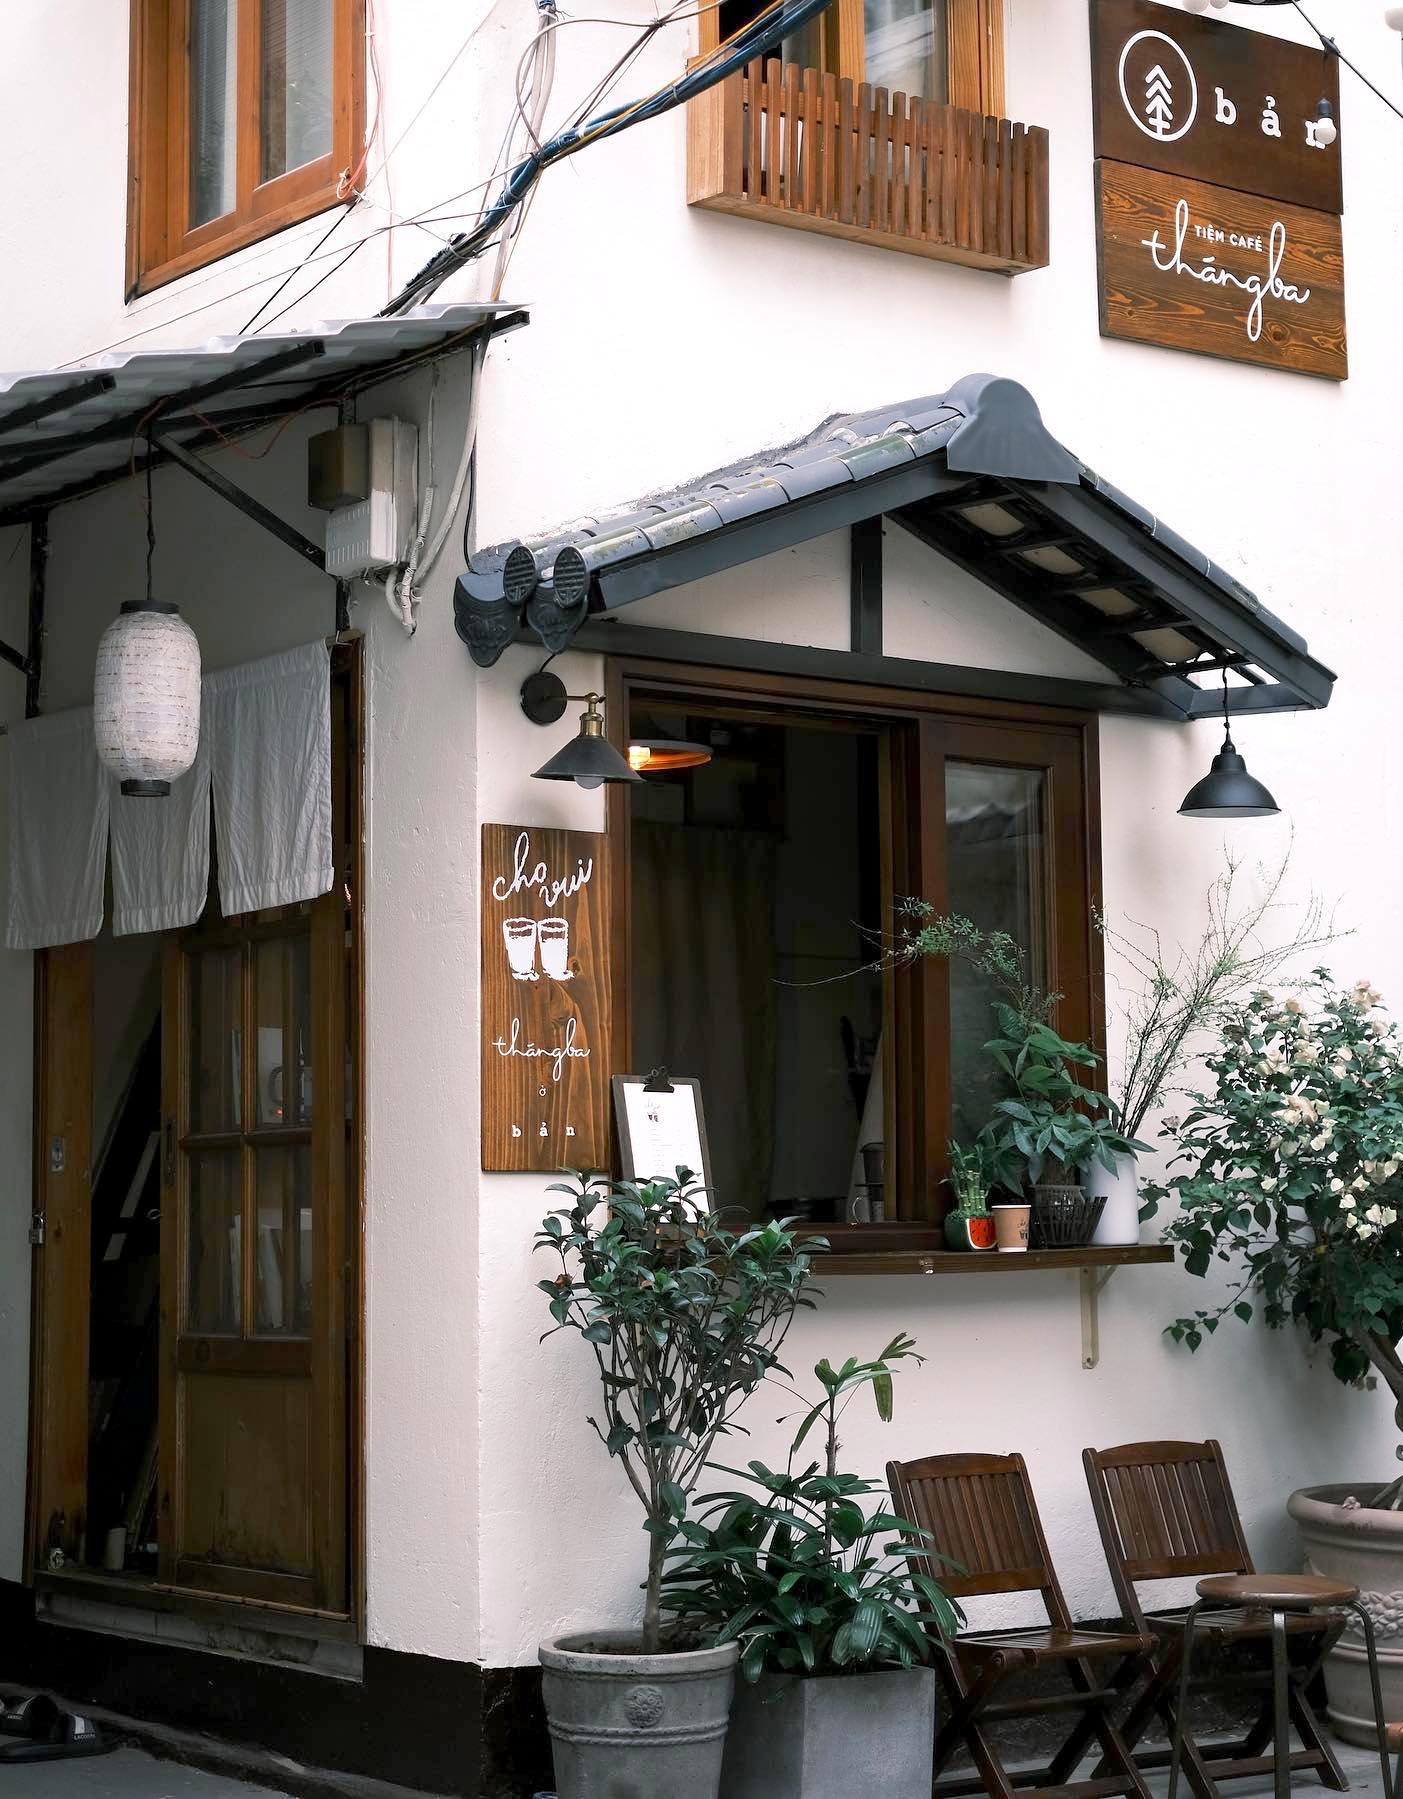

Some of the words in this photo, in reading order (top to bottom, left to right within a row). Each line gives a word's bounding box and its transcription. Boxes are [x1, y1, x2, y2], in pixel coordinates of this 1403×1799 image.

[1194, 224, 1225, 244] TIỆM
[1229, 234, 1263, 252] CAFÉ
[511, 1121, 576, 1138] bản
